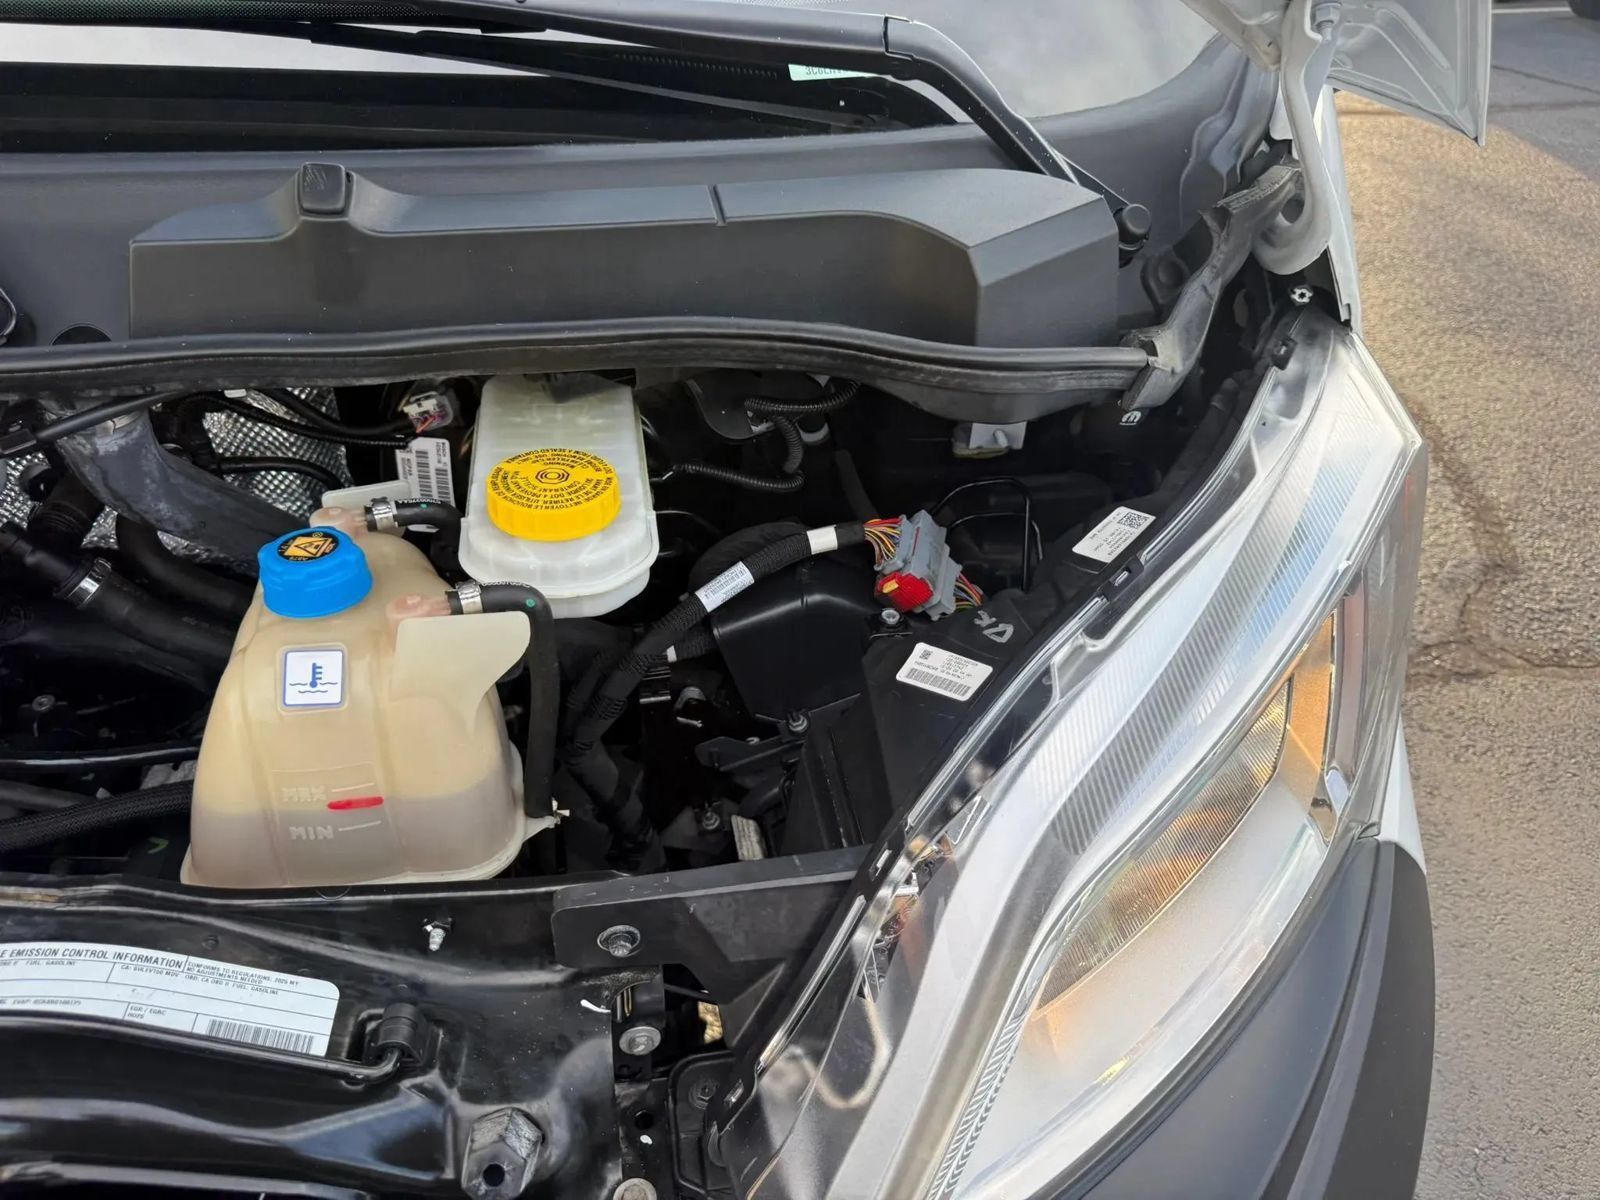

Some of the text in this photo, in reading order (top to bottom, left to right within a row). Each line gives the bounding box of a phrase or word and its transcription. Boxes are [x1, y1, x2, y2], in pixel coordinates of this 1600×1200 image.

[289, 825, 335, 841] MIN
[9, 948, 60, 958] EMISSION
[62, 948, 109, 960] CONTROL
[112, 951, 184, 969] INFORMATION
